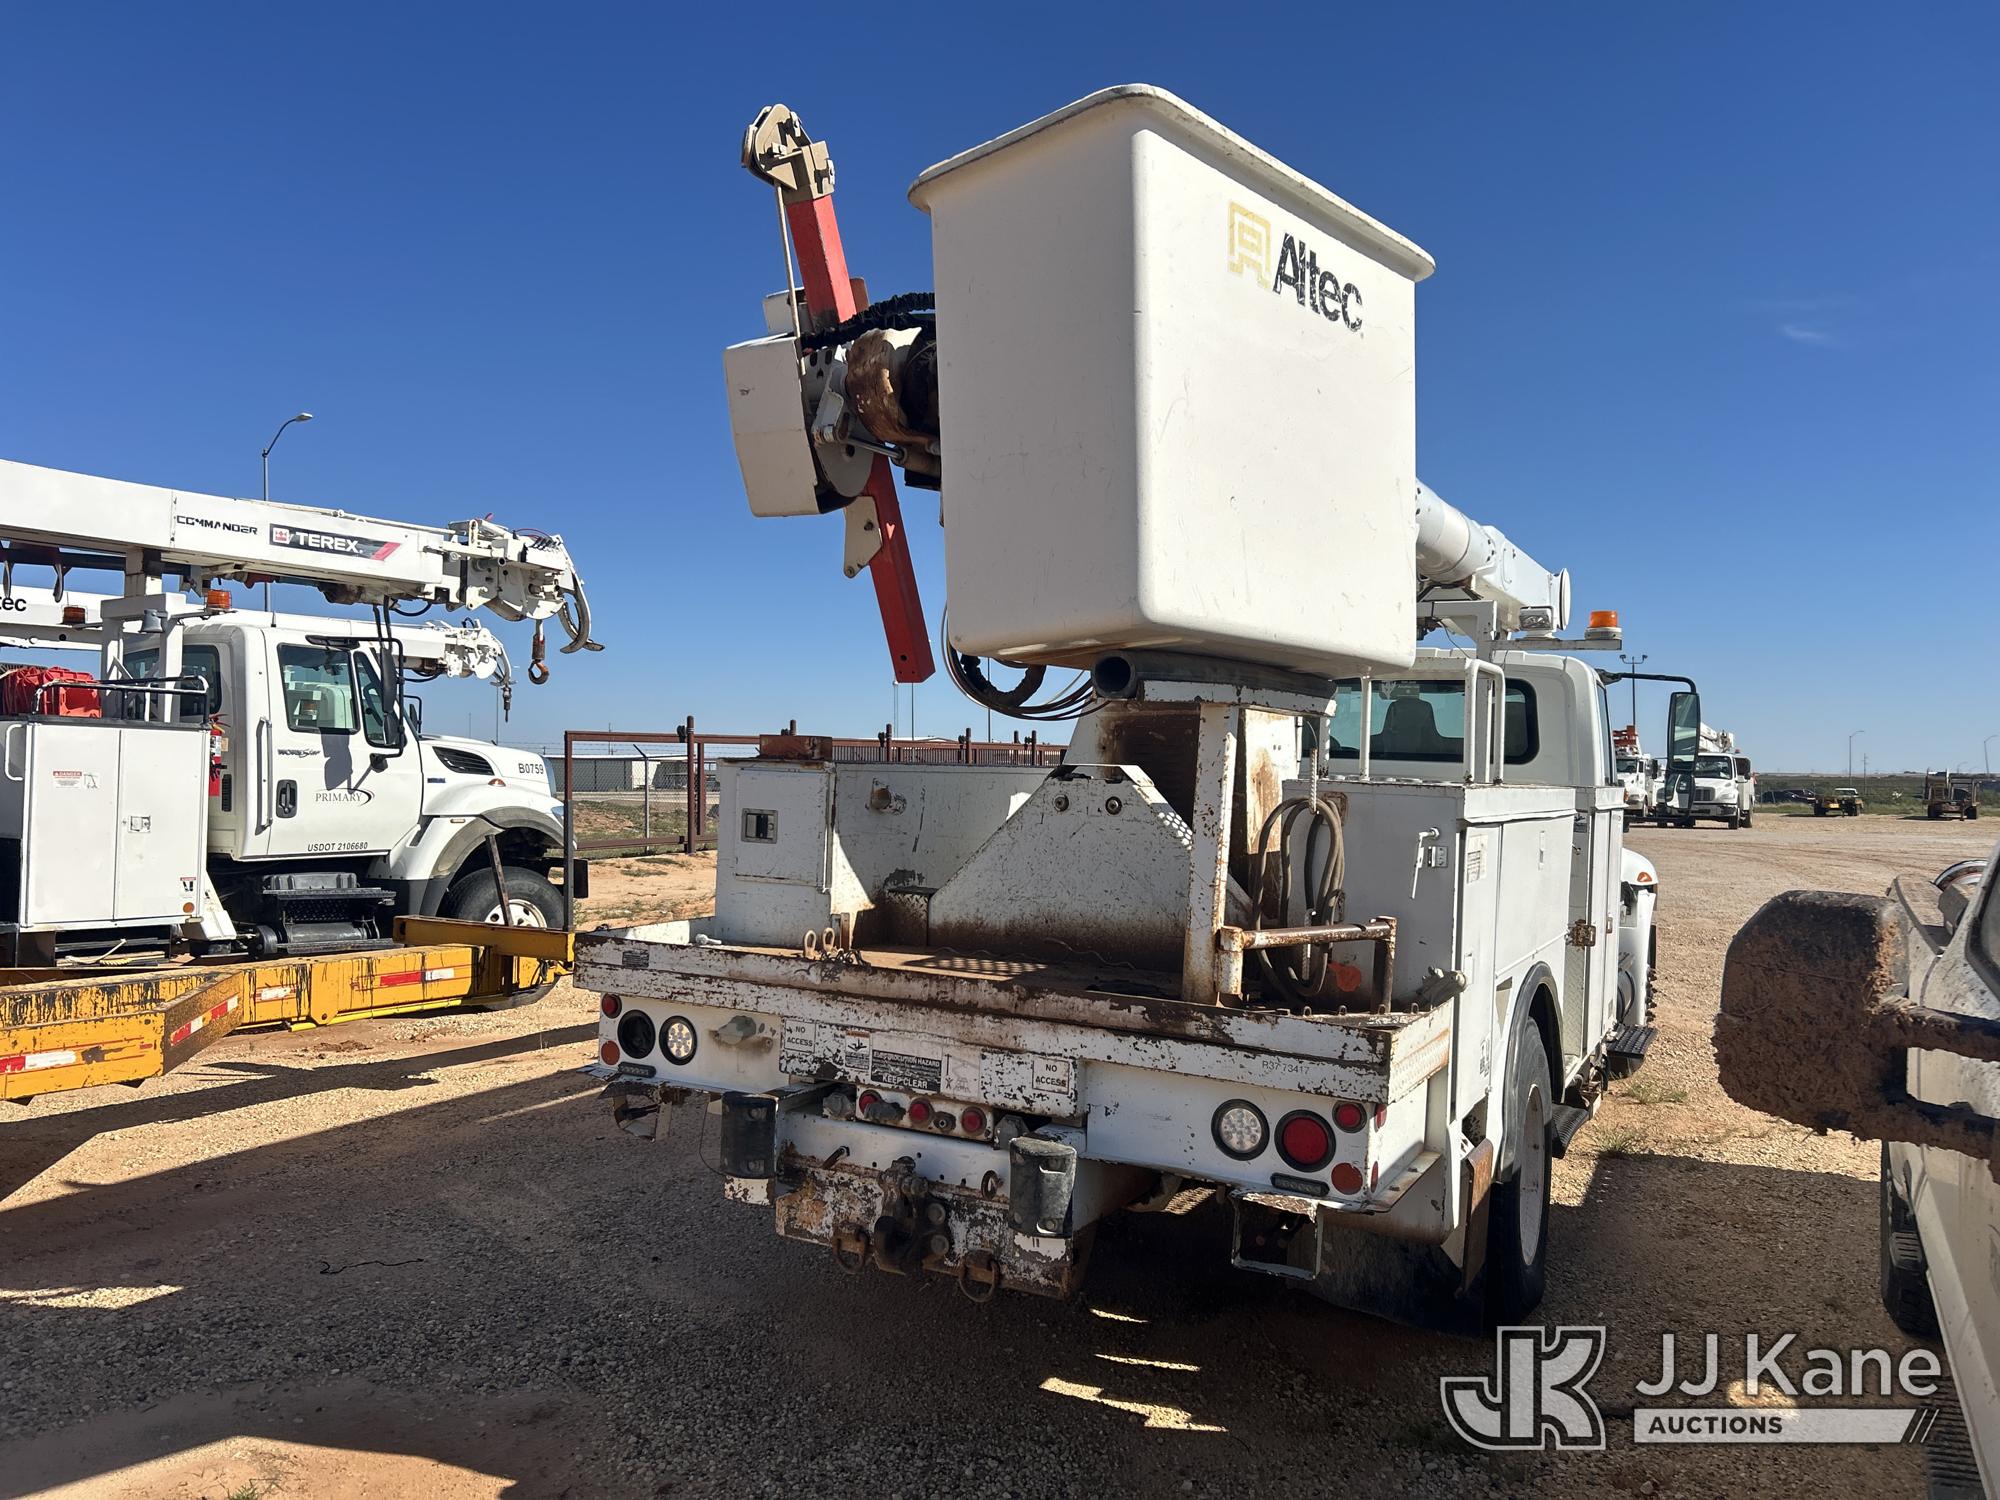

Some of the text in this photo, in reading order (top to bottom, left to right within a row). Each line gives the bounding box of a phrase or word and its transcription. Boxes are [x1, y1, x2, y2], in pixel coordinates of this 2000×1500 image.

[1272, 232, 1363, 332] Altec
[176, 515, 258, 535] COMMANDER
[295, 531, 361, 553] TEREX
[0, 597, 27, 612] ec
[518, 763, 545, 774] B0759
[315, 792, 362, 802] PRIMARY
[307, 841, 368, 852] USDOT 2106680
[795, 1026, 806, 1034] NO
[787, 1037, 813, 1047] ACCESS
[917, 1058, 940, 1067] HAZARD
[1046, 1064, 1058, 1072] NO
[882, 1073, 928, 1089] KEEP CLEAR
[1036, 1076, 1067, 1088] ACCESS
